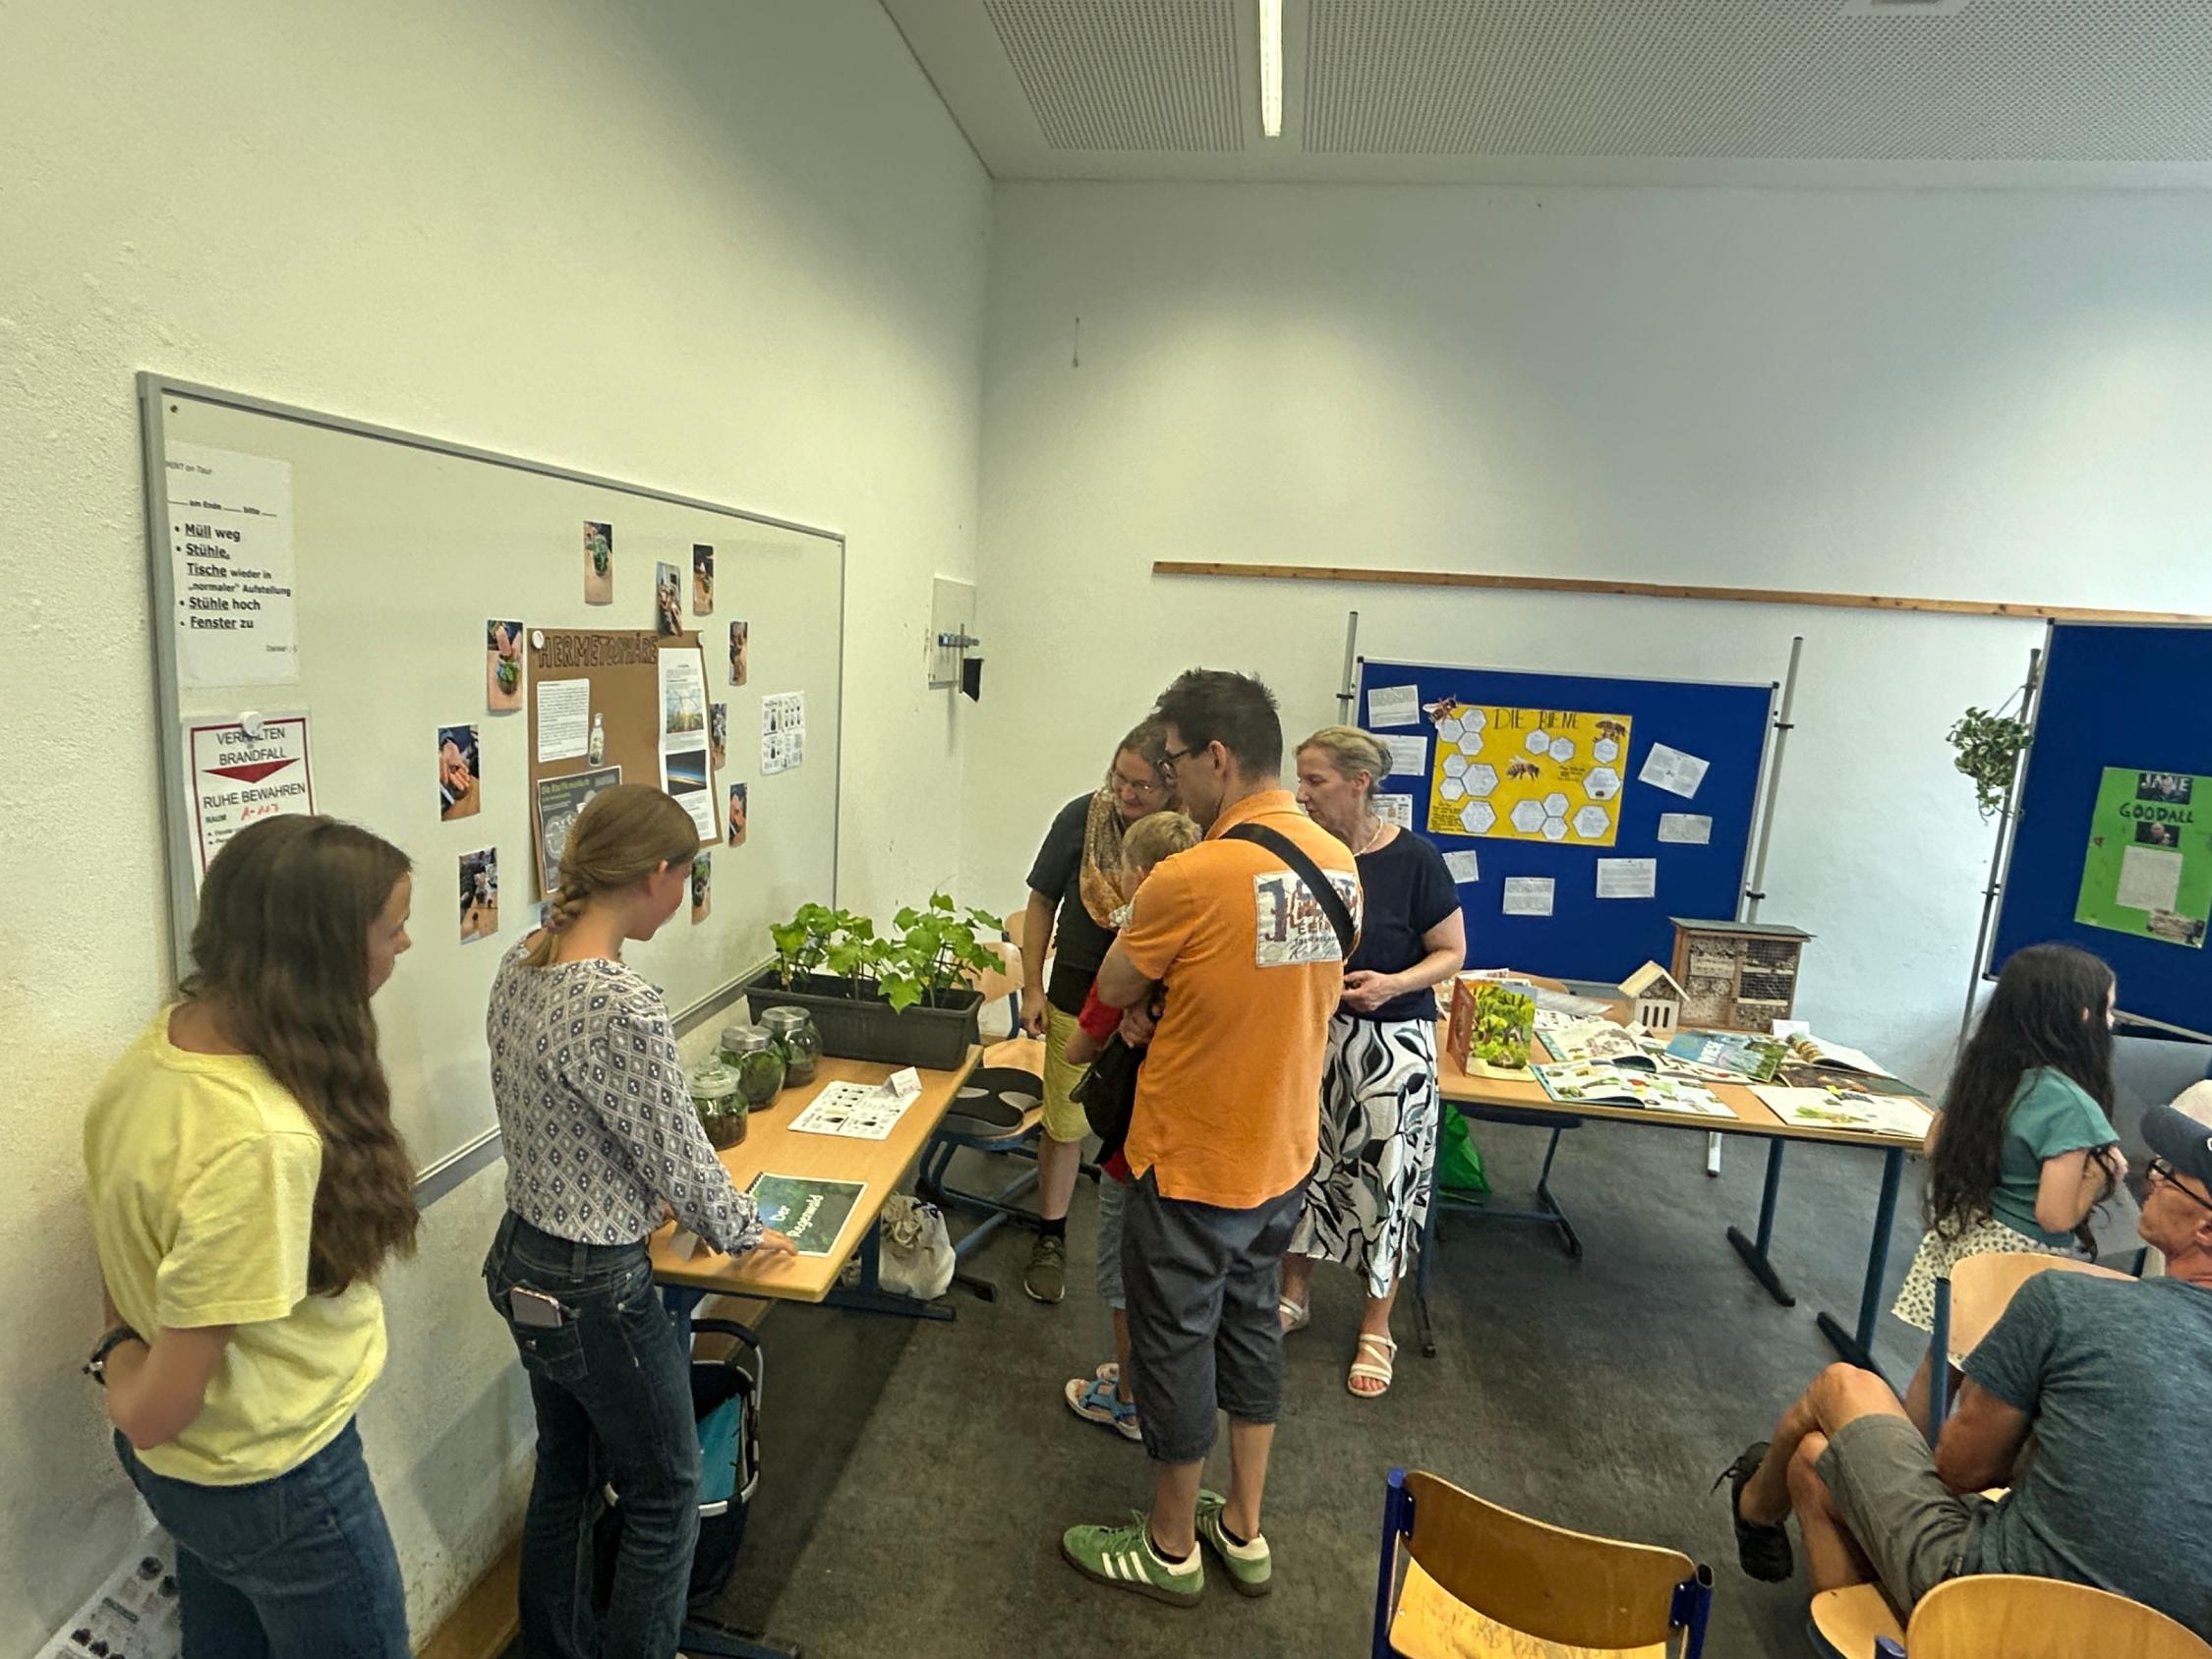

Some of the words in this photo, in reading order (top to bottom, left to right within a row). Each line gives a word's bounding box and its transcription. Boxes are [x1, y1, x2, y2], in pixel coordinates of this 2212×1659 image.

[203, 500, 221, 510] Ende
[185, 523, 211, 538] Müll
[214, 529, 241, 543] weg
[187, 562, 227, 577] Tische
[230, 568, 261, 579] wieder
[242, 585, 291, 597] Aufstellung
[189, 596, 229, 610] Stühle
[232, 598, 261, 610] hoch
[190, 615, 238, 629] Fenster
[240, 619, 254, 629] zu
[1494, 709, 1526, 729] DIE
[219, 747, 287, 766] BRANDFALL
[204, 792, 239, 809] RUHE
[242, 782, 306, 803] BEWAHREN
[2119, 802, 2194, 824] GOODALL
[769, 1204, 791, 1222] Der
[786, 1194, 825, 1238] Regenwald
